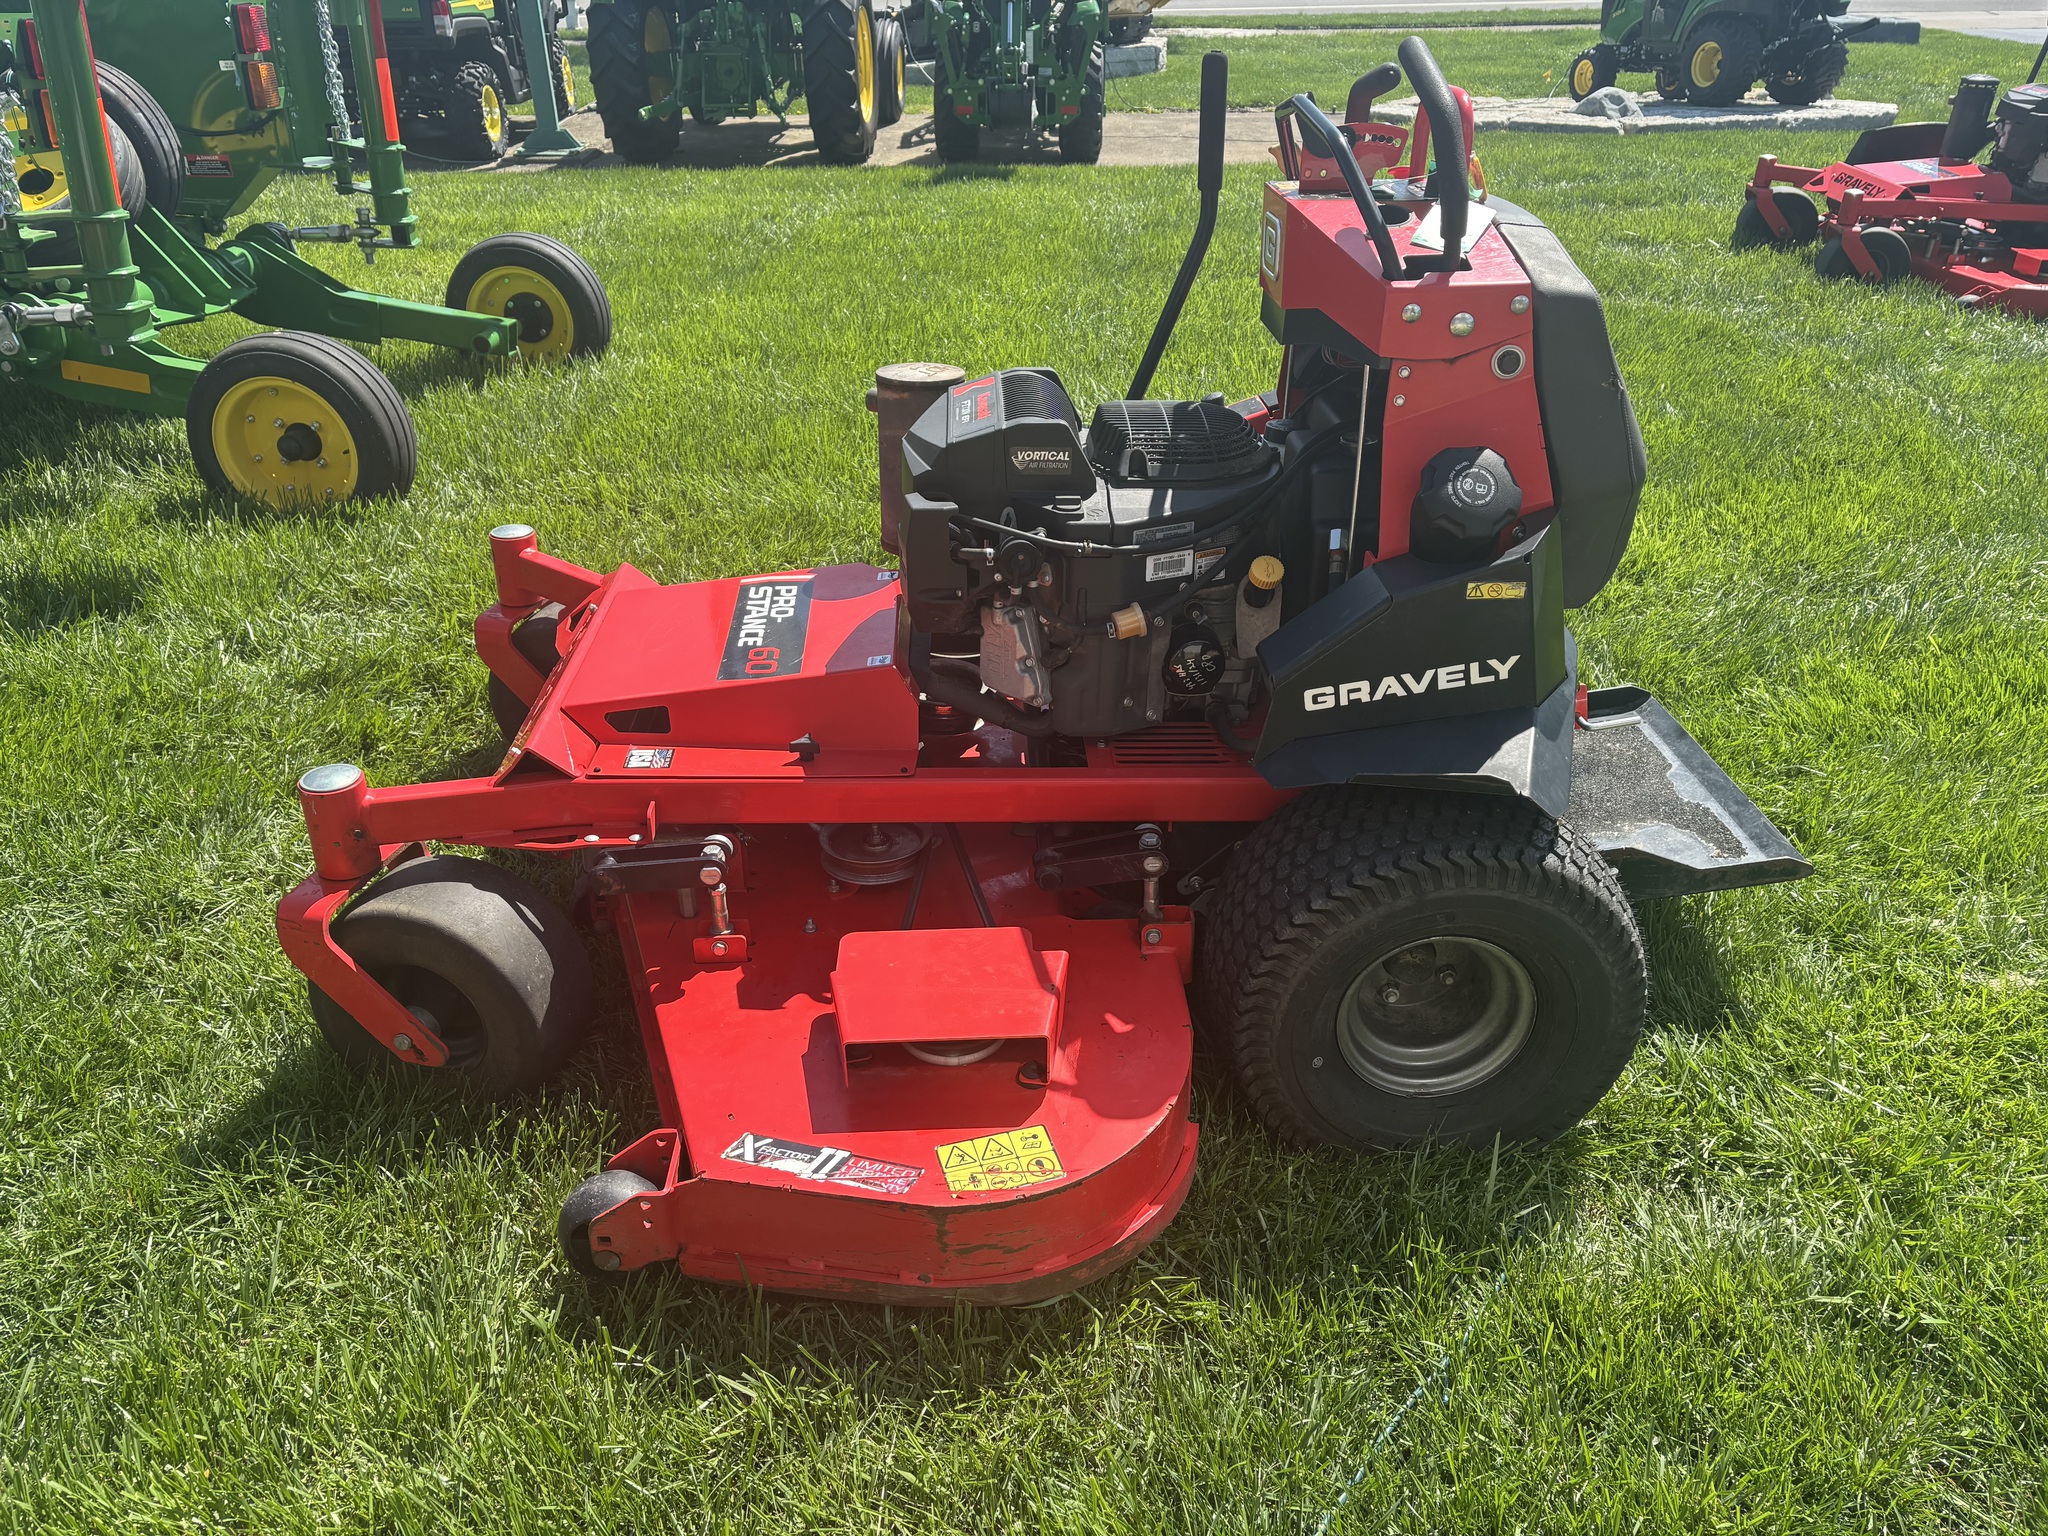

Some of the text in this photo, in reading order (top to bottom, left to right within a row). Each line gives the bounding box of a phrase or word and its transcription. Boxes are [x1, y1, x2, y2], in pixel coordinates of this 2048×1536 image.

[1834, 172, 1886, 198] GRAVELY
[1017, 451, 1070, 461] VORTICAL
[770, 586, 798, 622] PRO-
[737, 586, 780, 674] STANCE 60
[1303, 654, 1521, 712] GRAVELY
[628, 749, 655, 768] USA
[757, 1146, 810, 1160] FACTOR
[848, 1158, 916, 1177] LIMITED
